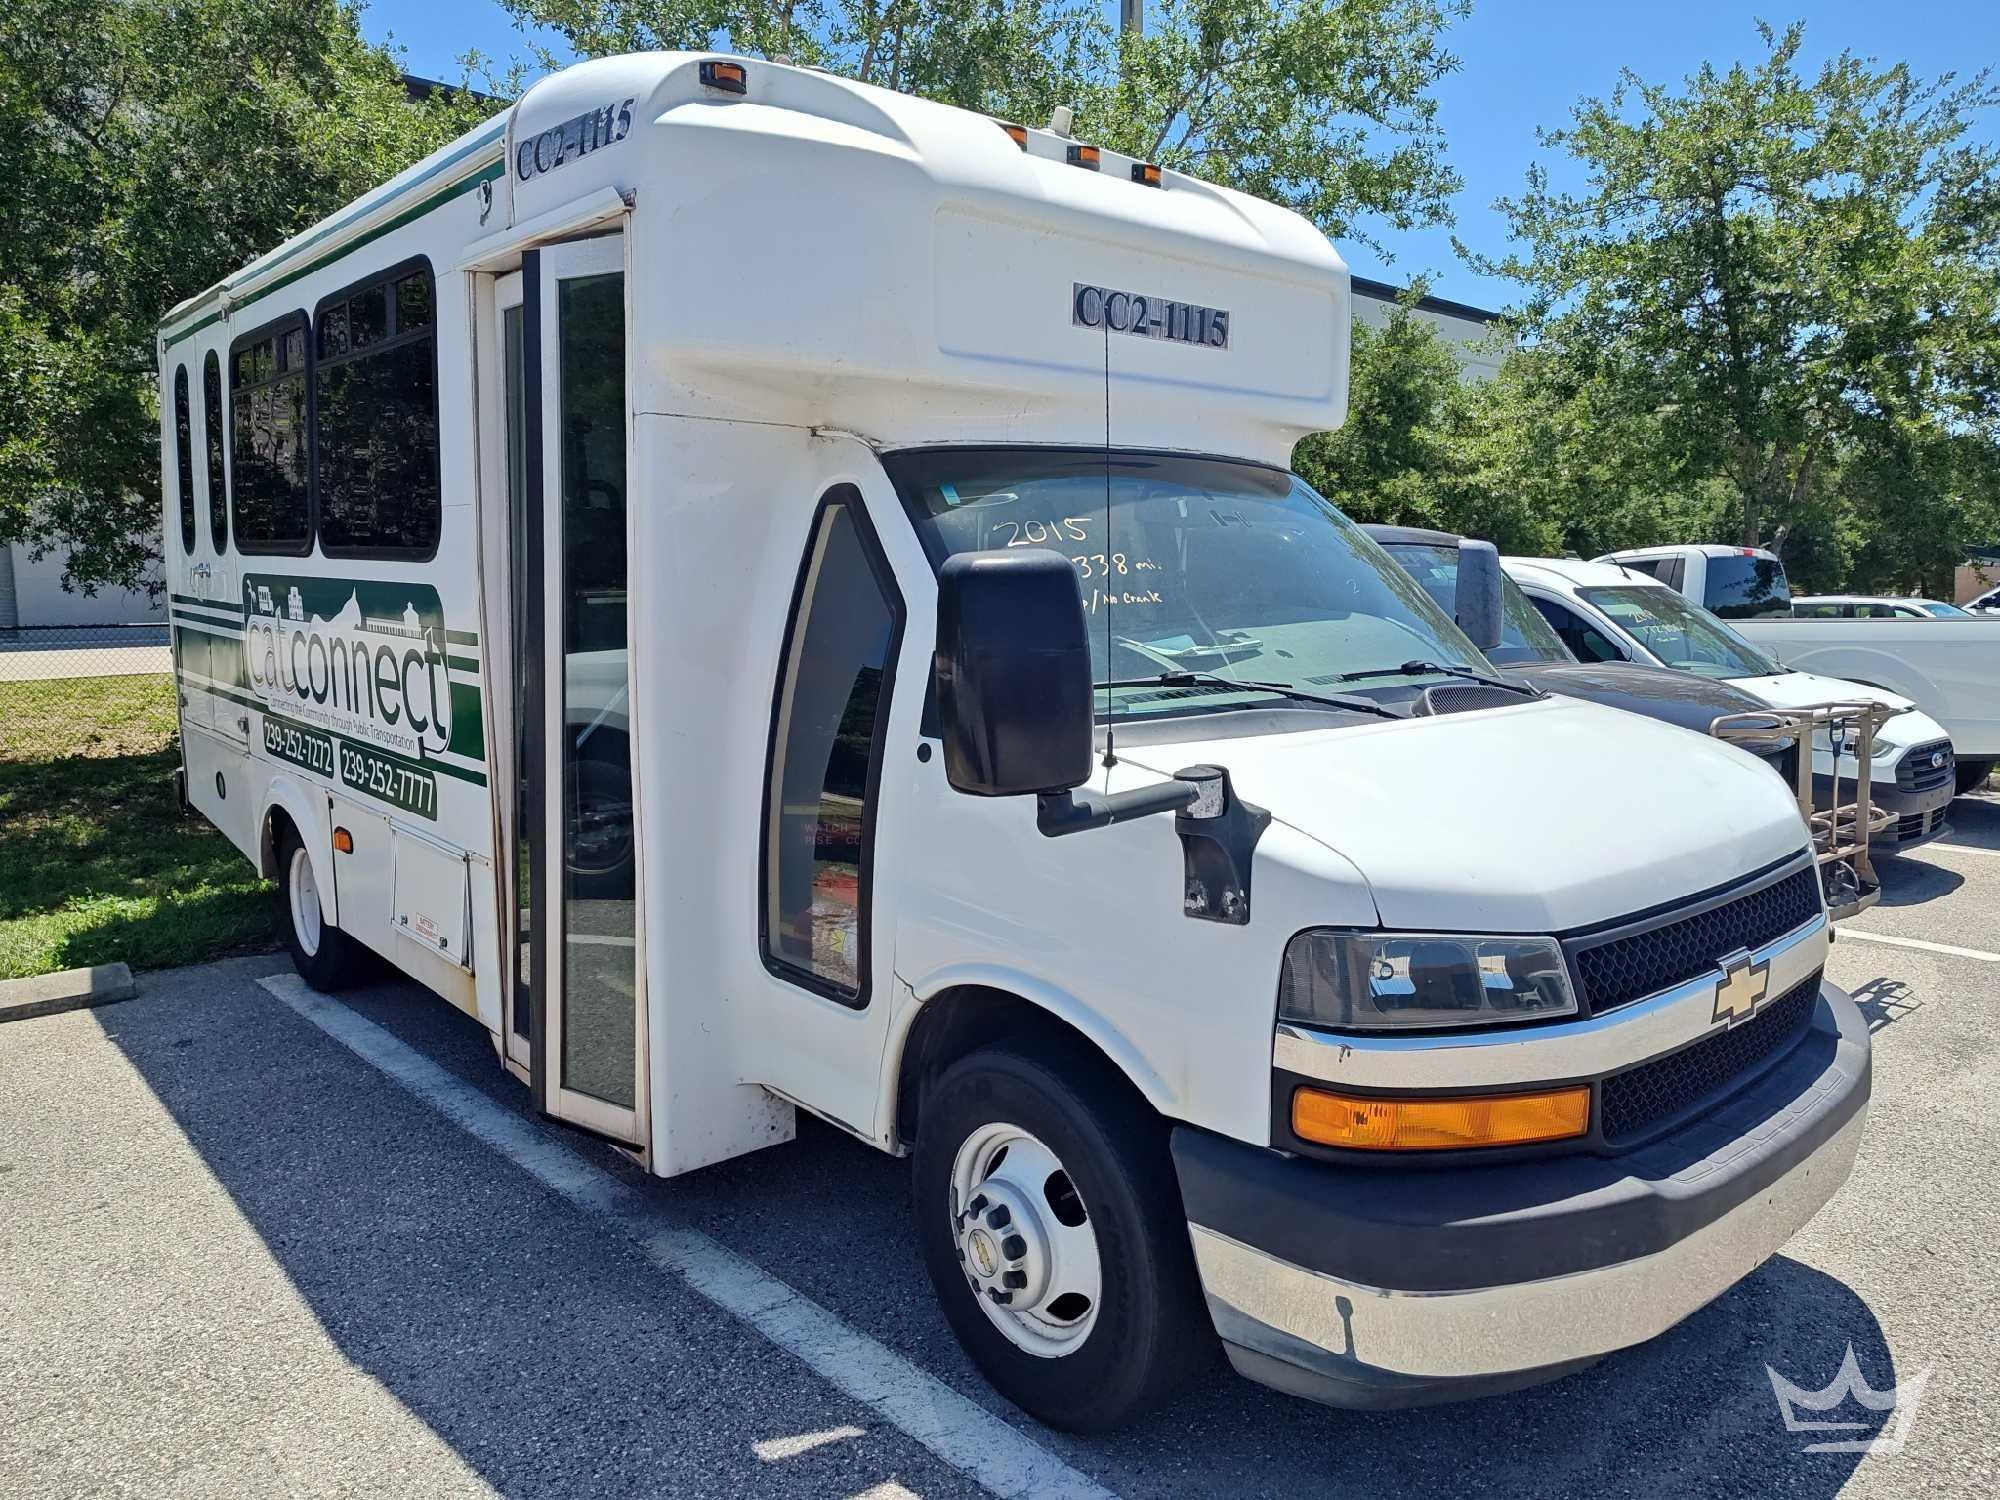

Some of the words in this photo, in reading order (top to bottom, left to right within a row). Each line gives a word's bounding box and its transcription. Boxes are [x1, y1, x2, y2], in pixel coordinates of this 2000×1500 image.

[517, 98, 635, 181] CC2-1115
[1075, 286, 1227, 347] CC2-1115
[992, 517, 1093, 547] 2015
[264, 721, 333, 772] 239-252-7272
[342, 748, 433, 813] 239-252-7777
[370, 723, 415, 751] Transportation
